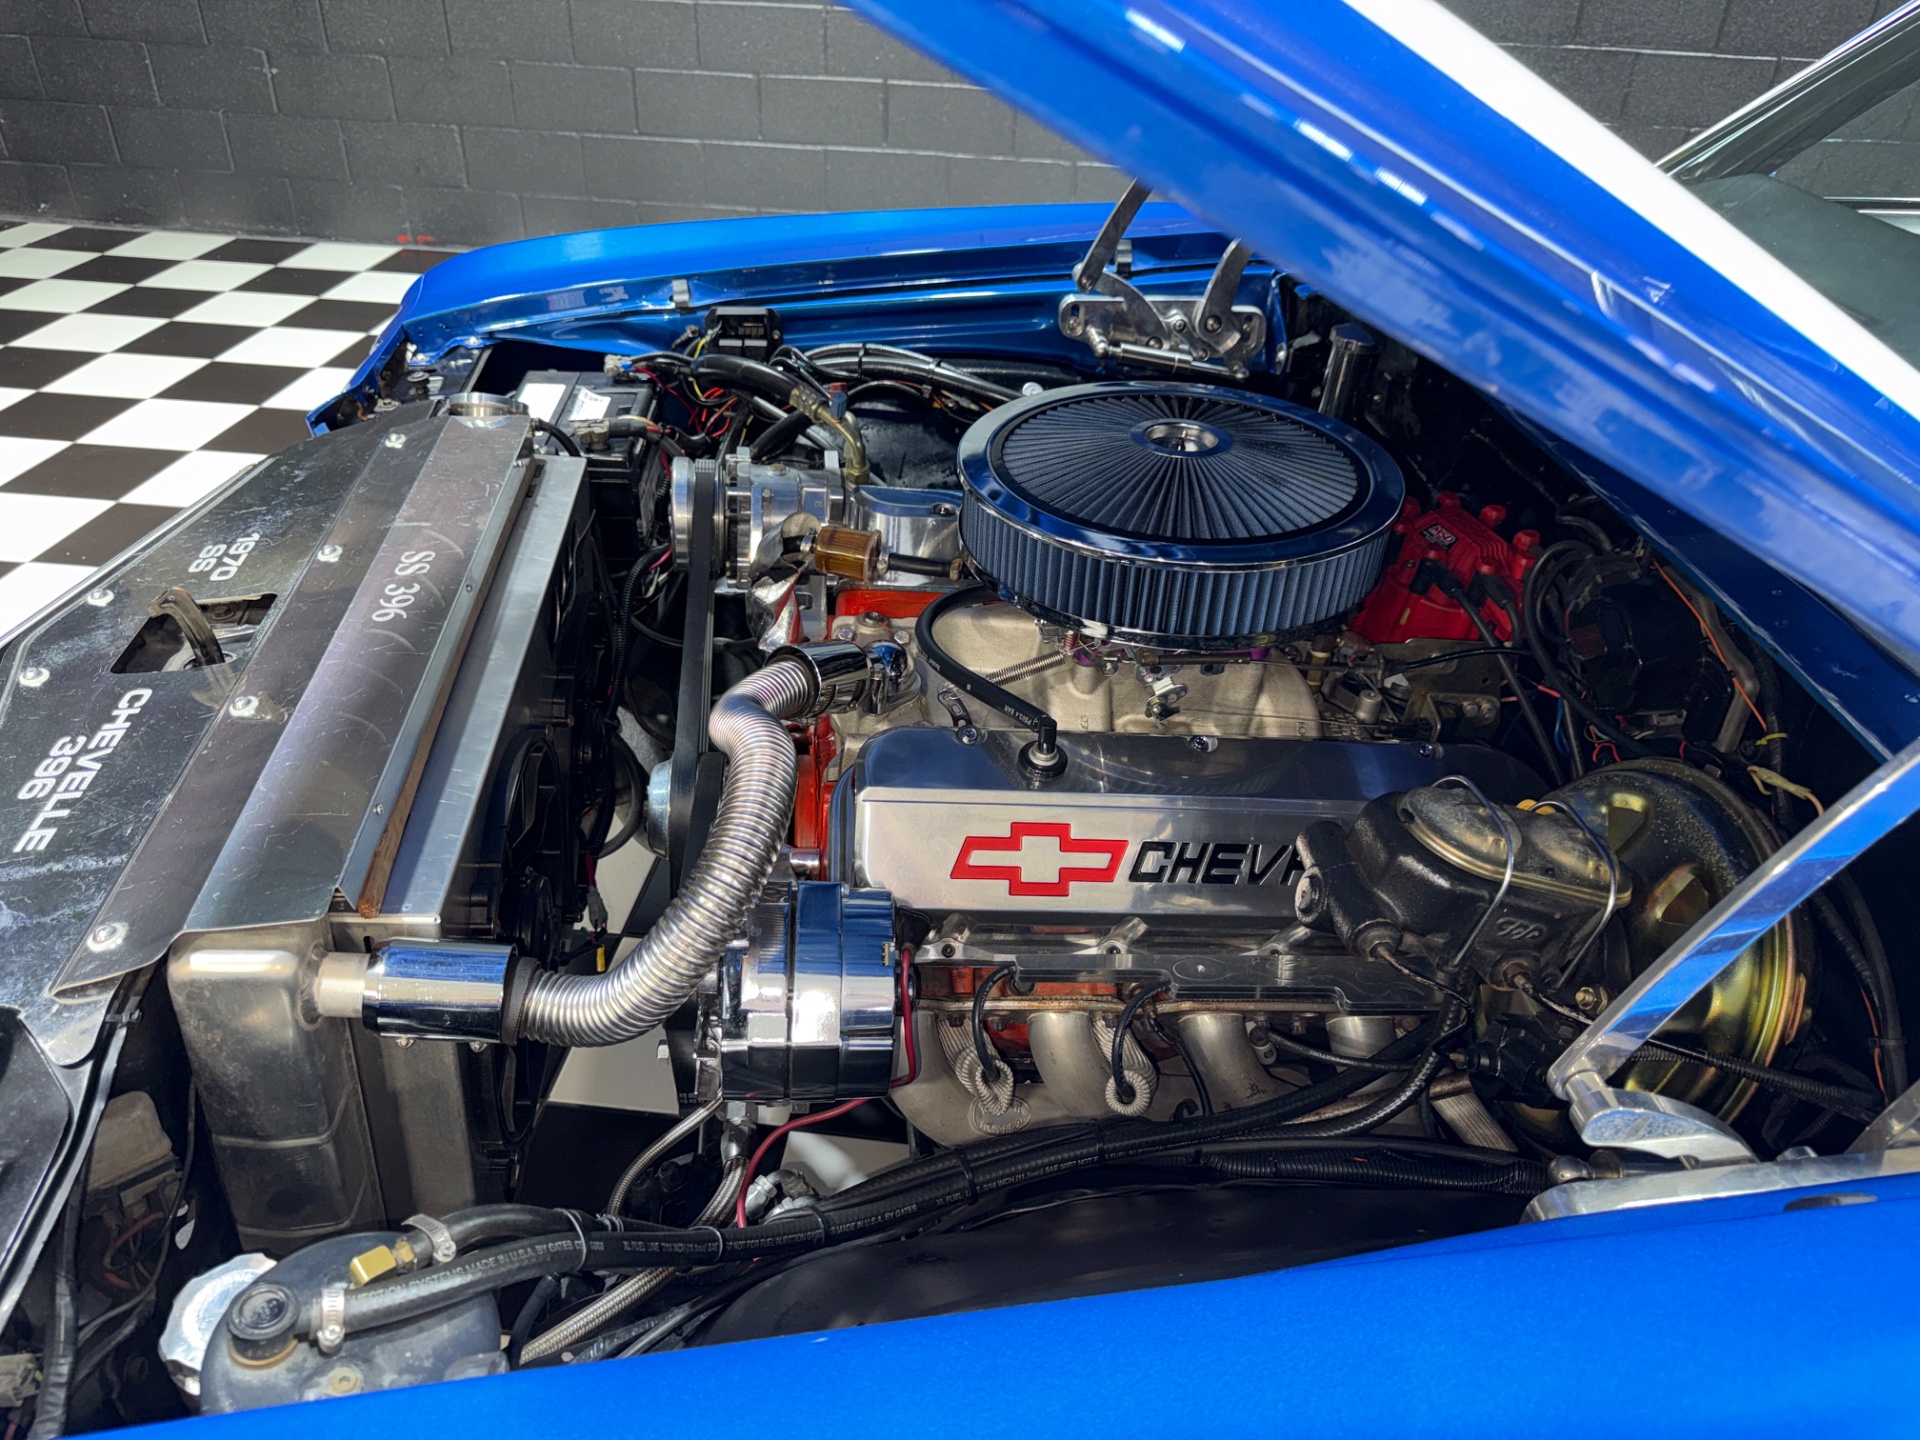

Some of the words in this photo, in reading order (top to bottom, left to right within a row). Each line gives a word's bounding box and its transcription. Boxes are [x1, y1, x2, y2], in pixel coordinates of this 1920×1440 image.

[1429, 525, 1456, 544] MSD
[188, 543, 225, 575] SS
[209, 532, 260, 582] 1970
[394, 550, 436, 577] SS
[372, 580, 421, 622] 396
[14, 687, 153, 855] CHEVELLE
[17, 735, 86, 801] 396
[894, 1204, 918, 1218] GATES
